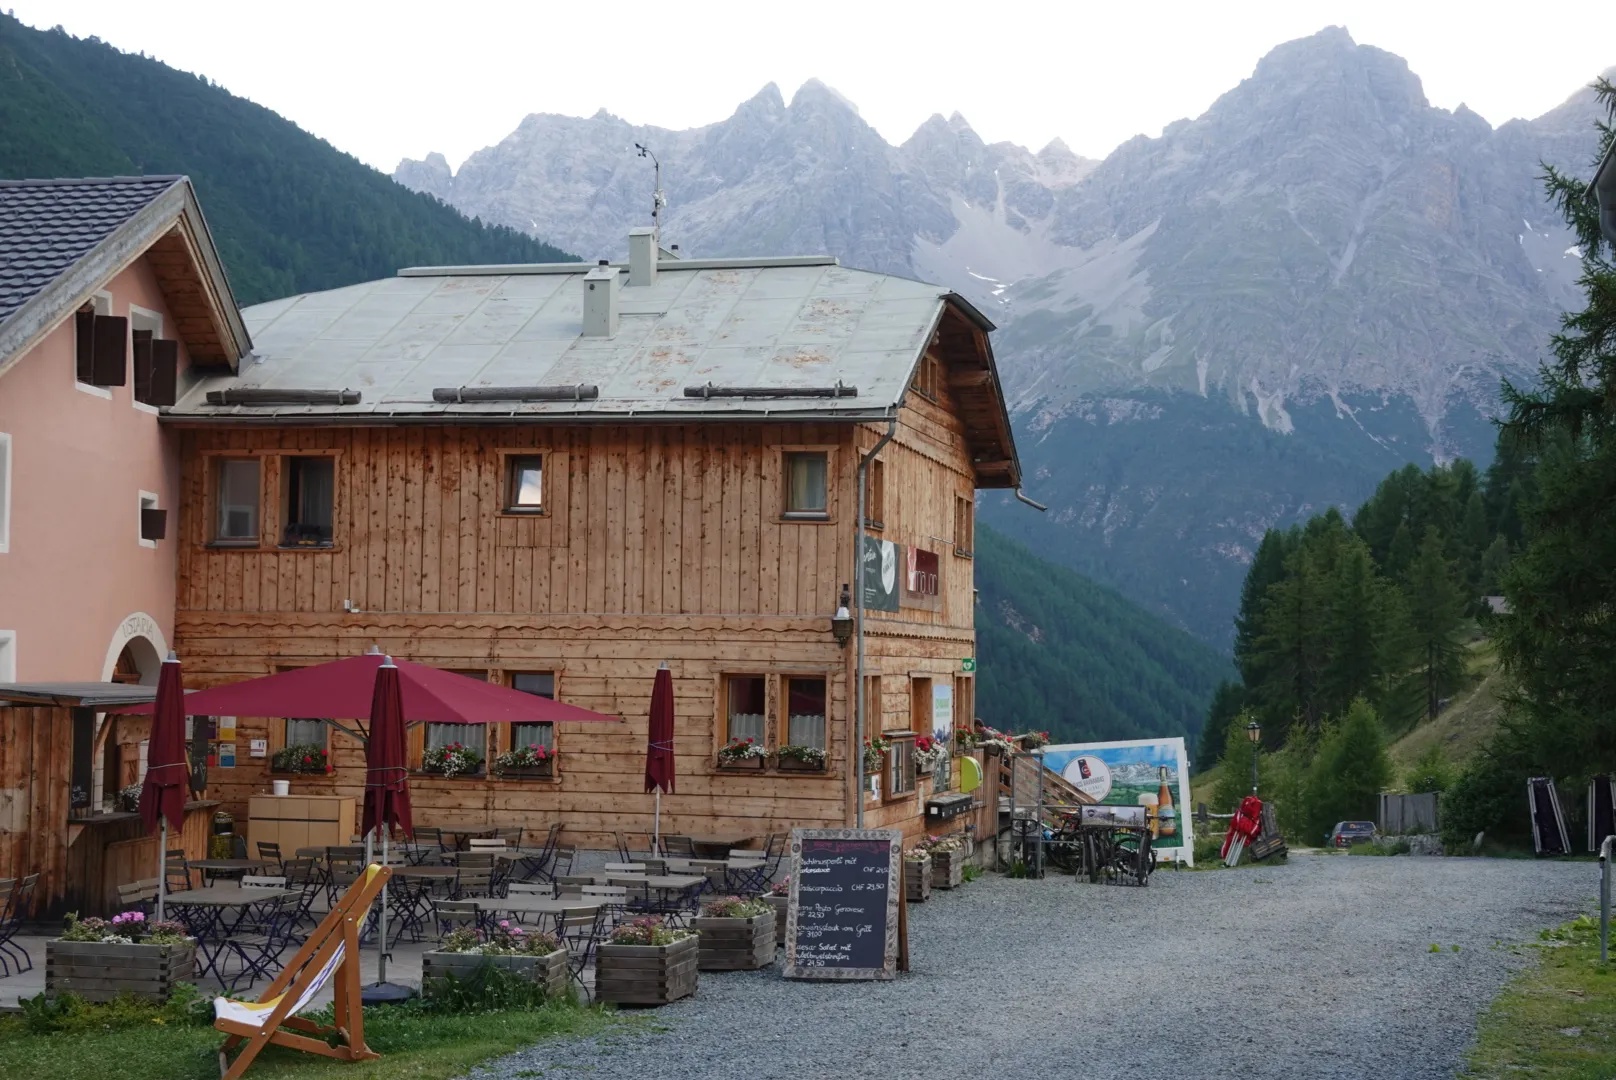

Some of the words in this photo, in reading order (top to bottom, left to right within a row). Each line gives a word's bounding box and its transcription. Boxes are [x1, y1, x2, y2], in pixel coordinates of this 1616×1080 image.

[844, 857, 857, 865] mit
[851, 883, 865, 891] CHF
[840, 943, 852, 951] mit
[795, 958, 805, 966] HF
